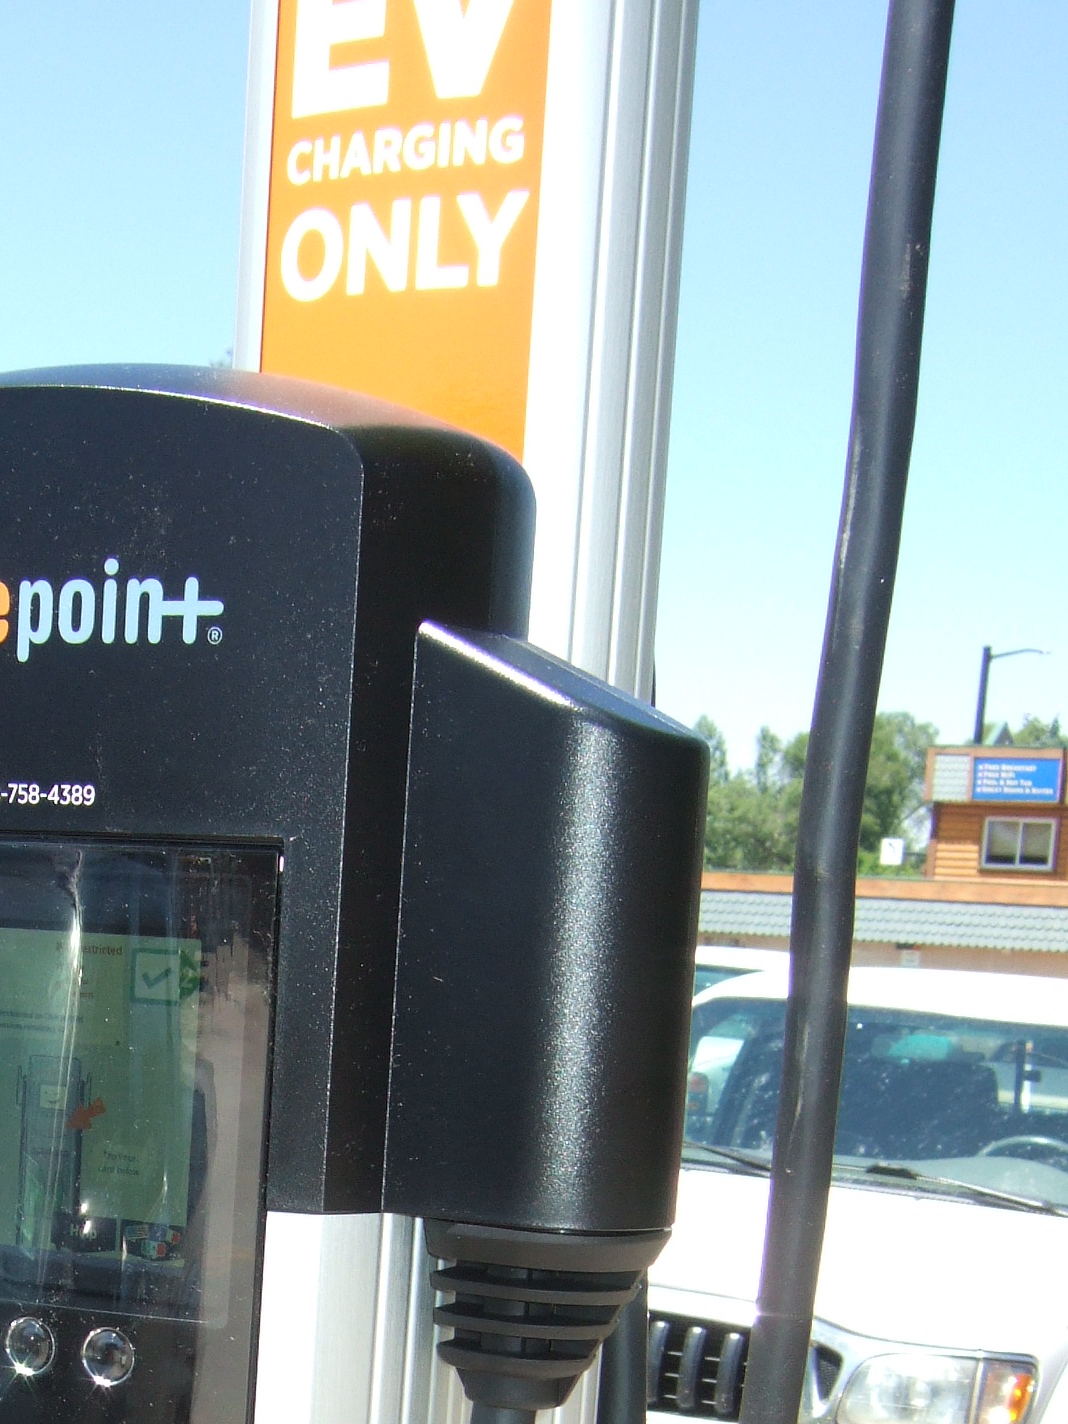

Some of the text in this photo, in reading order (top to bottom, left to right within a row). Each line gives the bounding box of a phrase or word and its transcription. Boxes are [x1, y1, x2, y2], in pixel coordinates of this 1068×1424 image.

[292, 0, 515, 119] EV
[287, 115, 525, 186] CHARGING
[280, 190, 531, 303] ONLY
